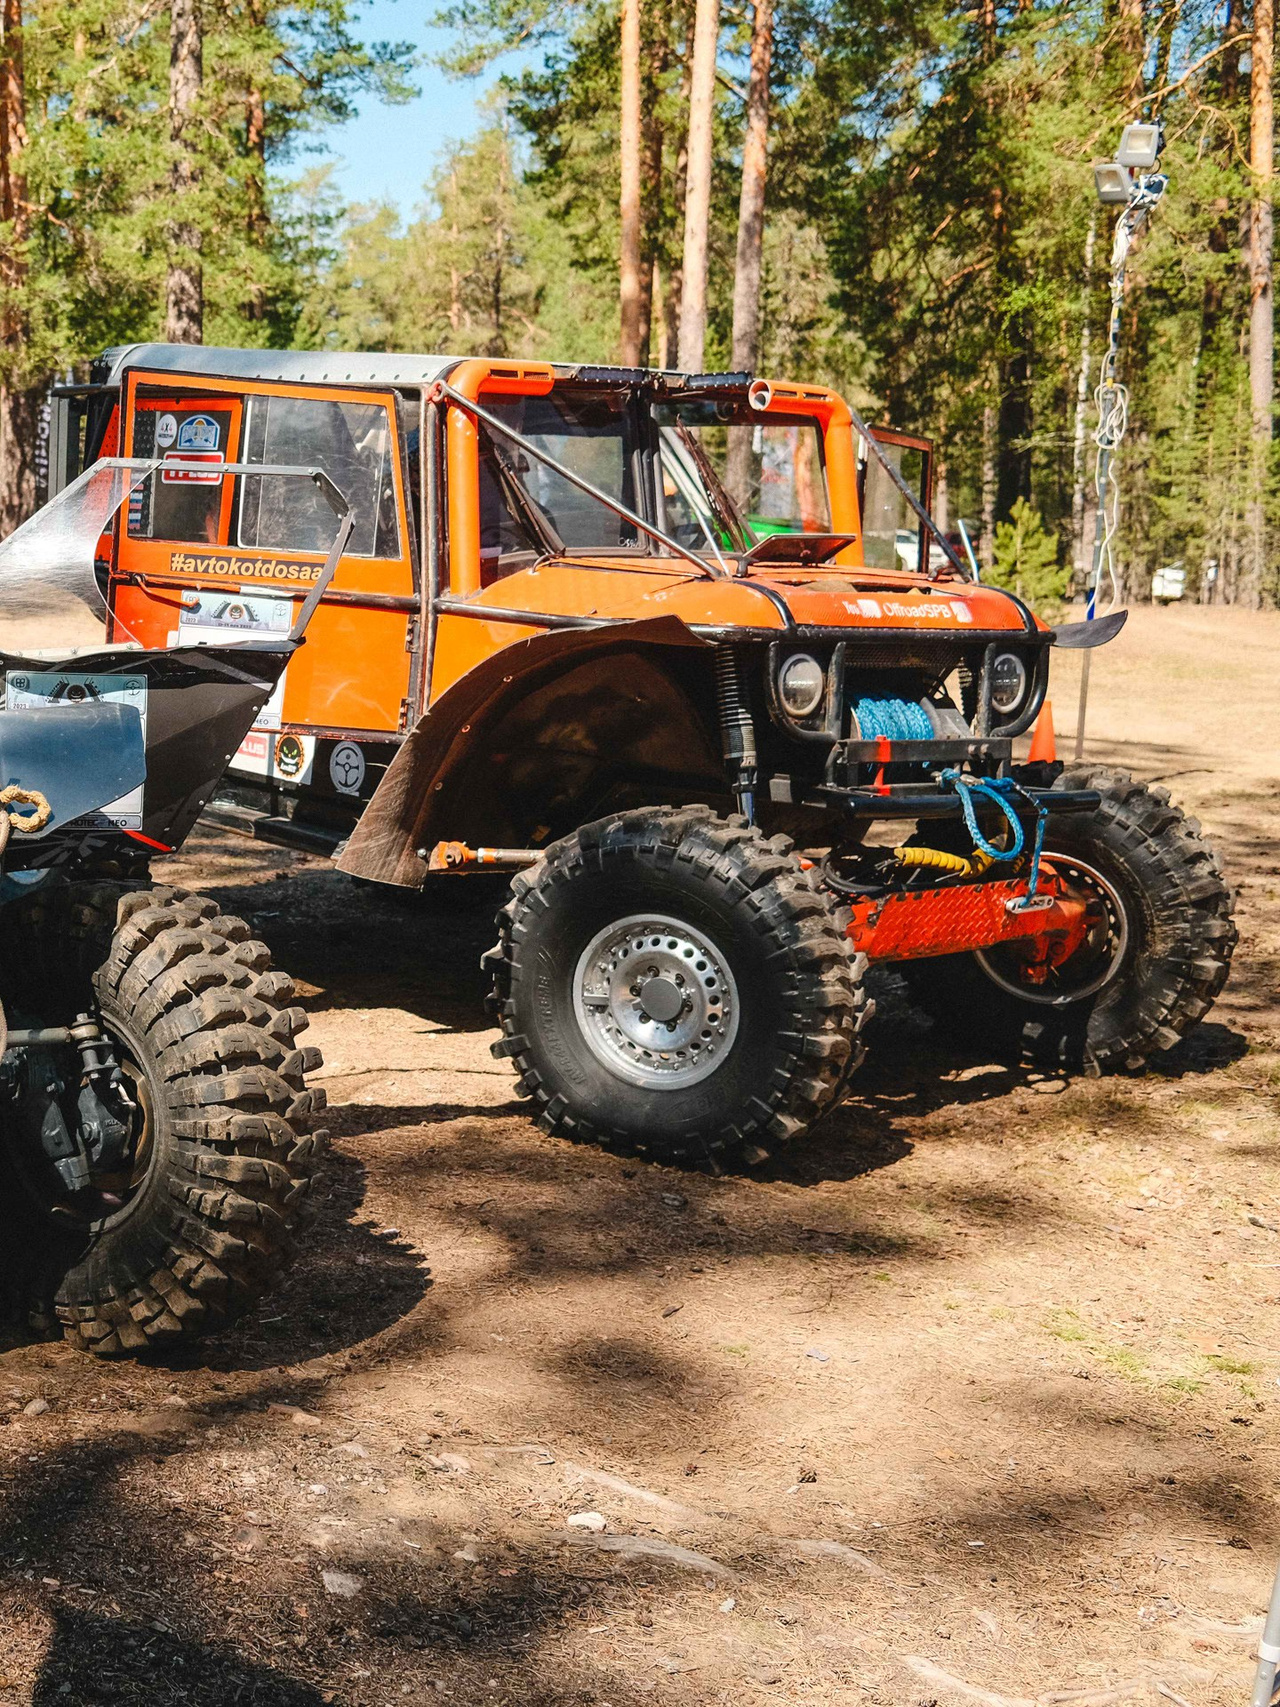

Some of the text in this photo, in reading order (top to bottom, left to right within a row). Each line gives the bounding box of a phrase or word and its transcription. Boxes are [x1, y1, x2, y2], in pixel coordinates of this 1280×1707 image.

[171, 553, 326, 580] #avtokotdosaa
[882, 602, 952, 618] OffroadSPB
[241, 740, 265, 754] LUS
